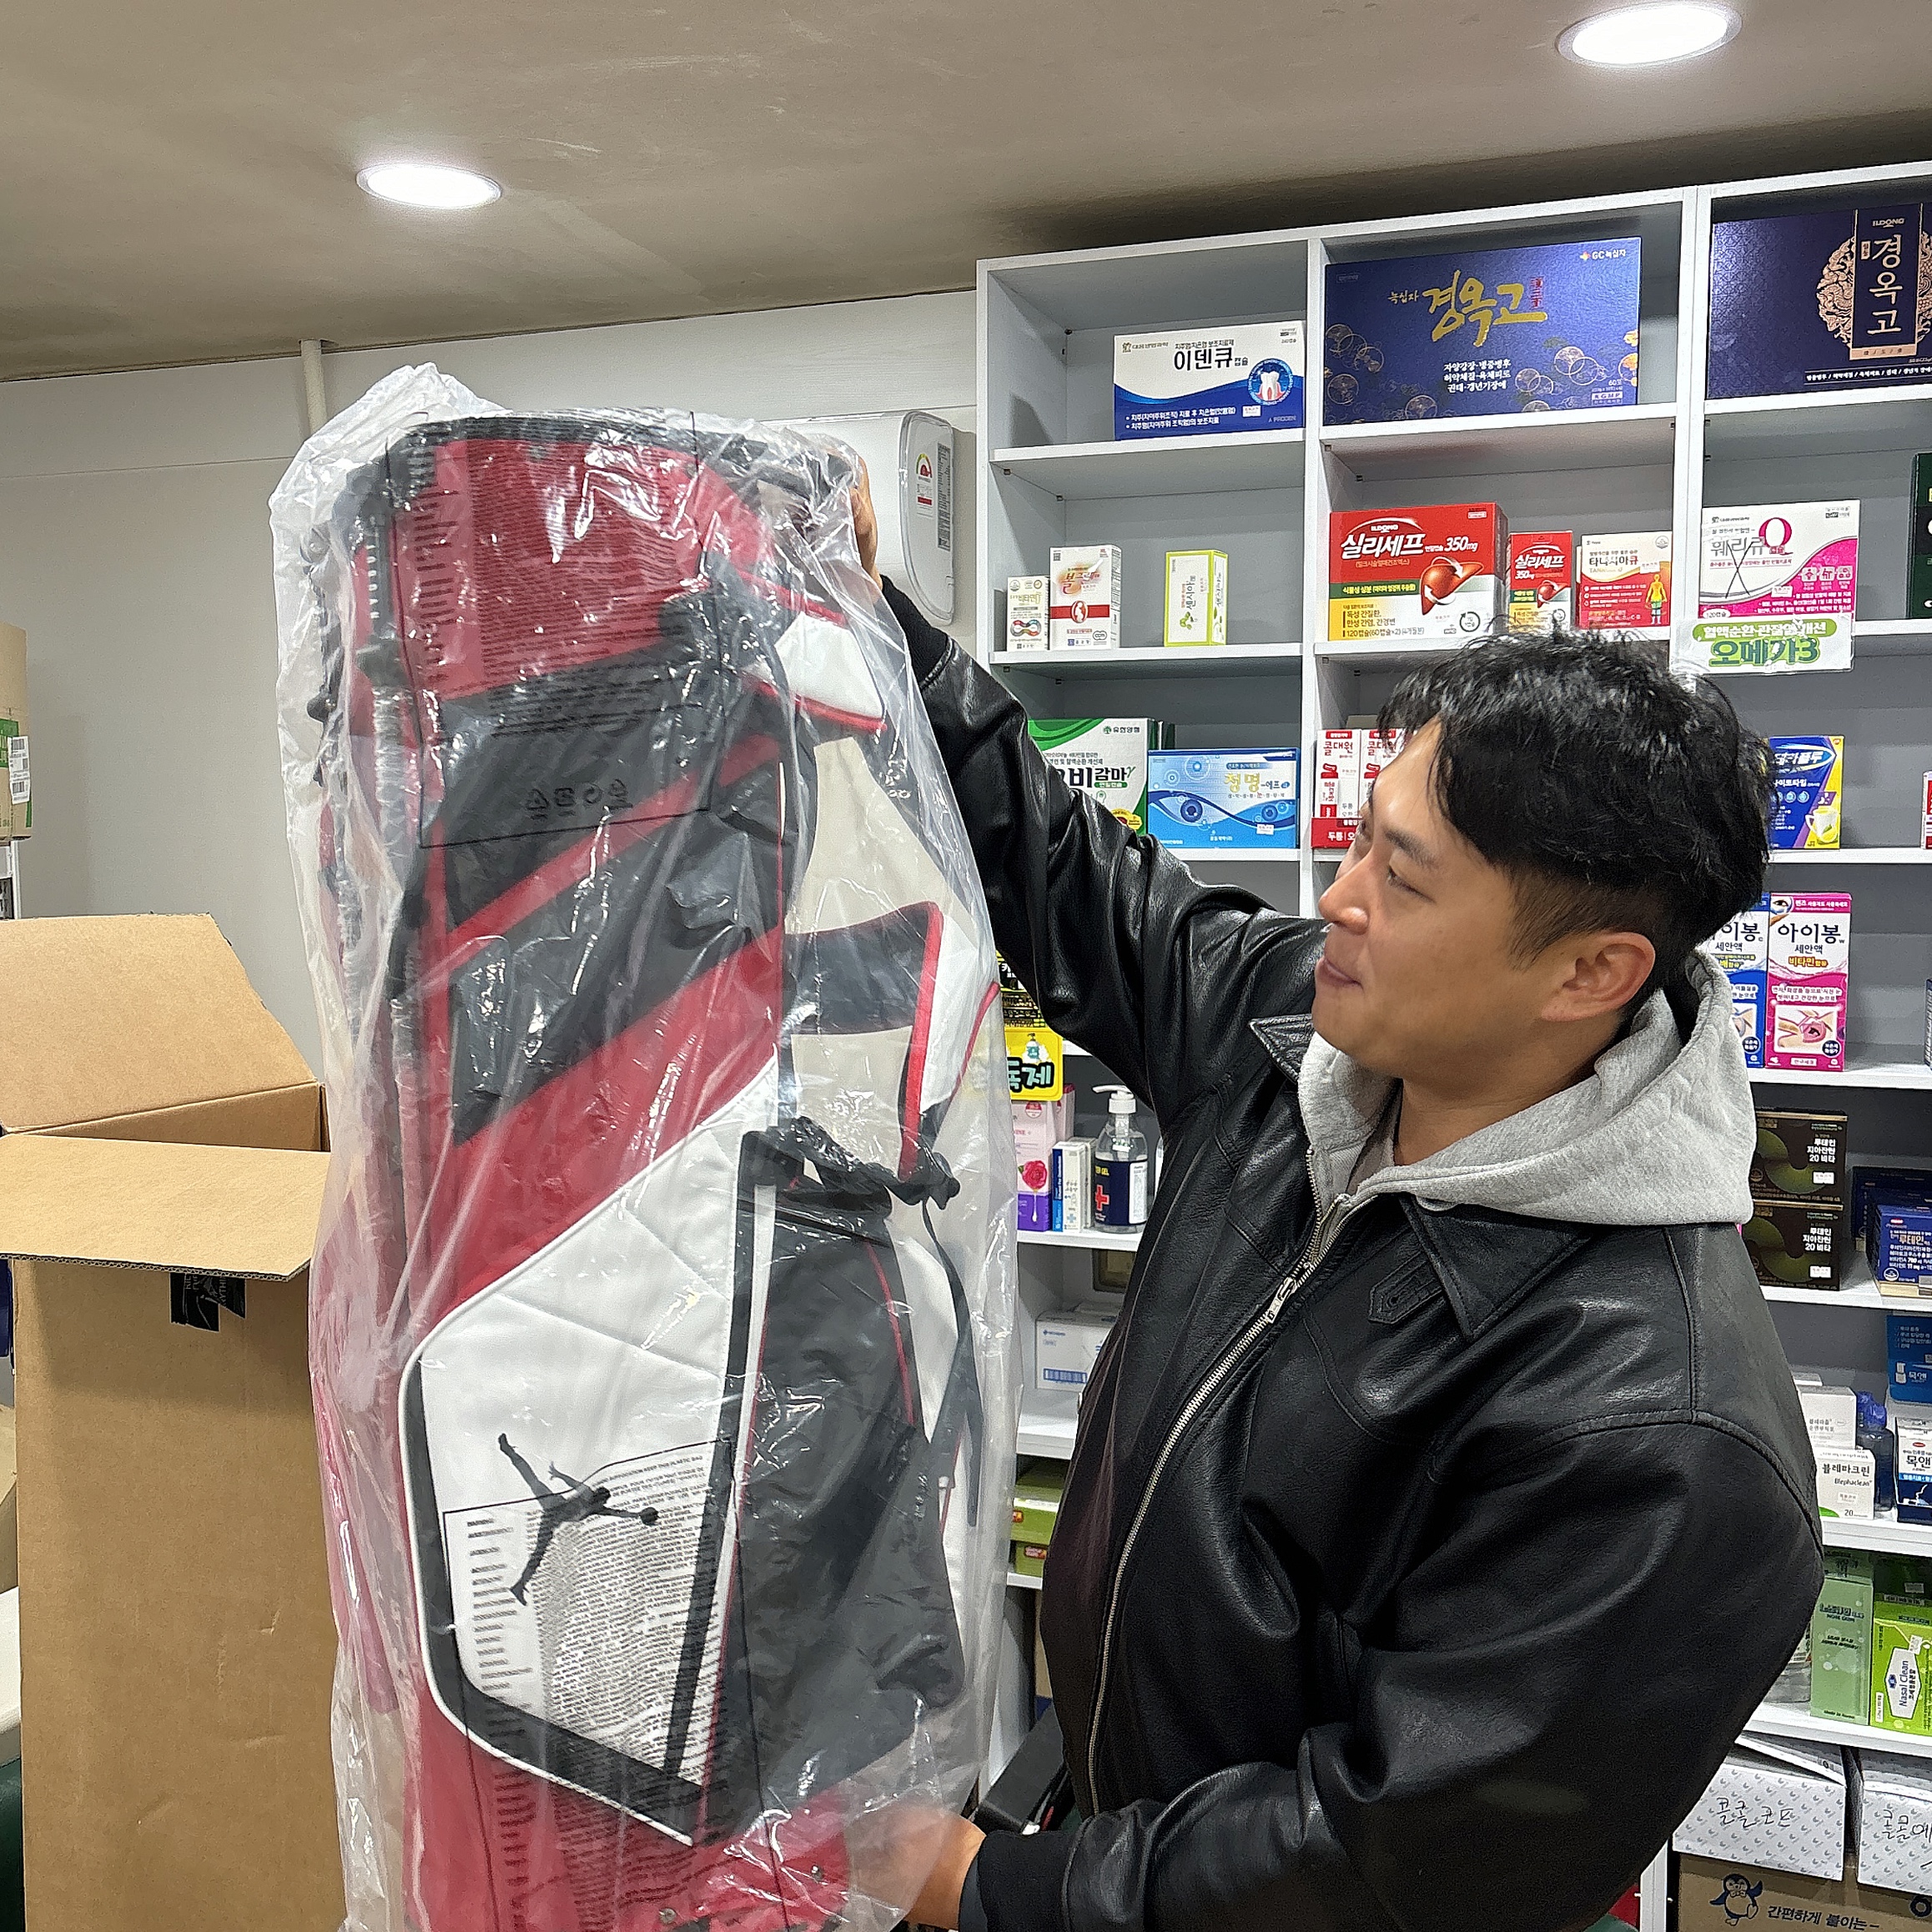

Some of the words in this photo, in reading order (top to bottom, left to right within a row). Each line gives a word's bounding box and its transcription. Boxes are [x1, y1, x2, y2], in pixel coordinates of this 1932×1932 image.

[1872, 218, 1904, 228] ILDONG
[1592, 251, 1605, 260] GC
[1605, 249, 1626, 259] 녹십자
[1867, 234, 1903, 335] 경옥고
[1387, 289, 1419, 304] 녹십자
[1421, 269, 1548, 347] 경옥고
[1174, 347, 1233, 371] 이덴큐
[1235, 357, 1249, 366] 캡슐
[1341, 533, 1426, 560] 실리세프
[1514, 554, 1566, 569] 실리세프
[1346, 619, 1360, 627] 만성
[1710, 637, 1818, 666] 오메가3
[1323, 741, 1354, 757] 콜대원
[1778, 923, 1841, 944] 아이봉
[1715, 943, 1743, 953] 세안액
[1794, 944, 1823, 954] 세안액
[1008, 1059, 1054, 1089] 독제
[1809, 1155, 1819, 1163] 20
[1820, 1155, 1835, 1164] 비타
[1804, 1243, 1815, 1251] 20
[1816, 1244, 1831, 1252] 비타
[1906, 1456, 1931, 1468] 목앤
[1900, 1660, 1909, 1683] Clean
[1899, 1686, 1909, 1707] Nasal
[1768, 1905, 1822, 1925] 간편하게
